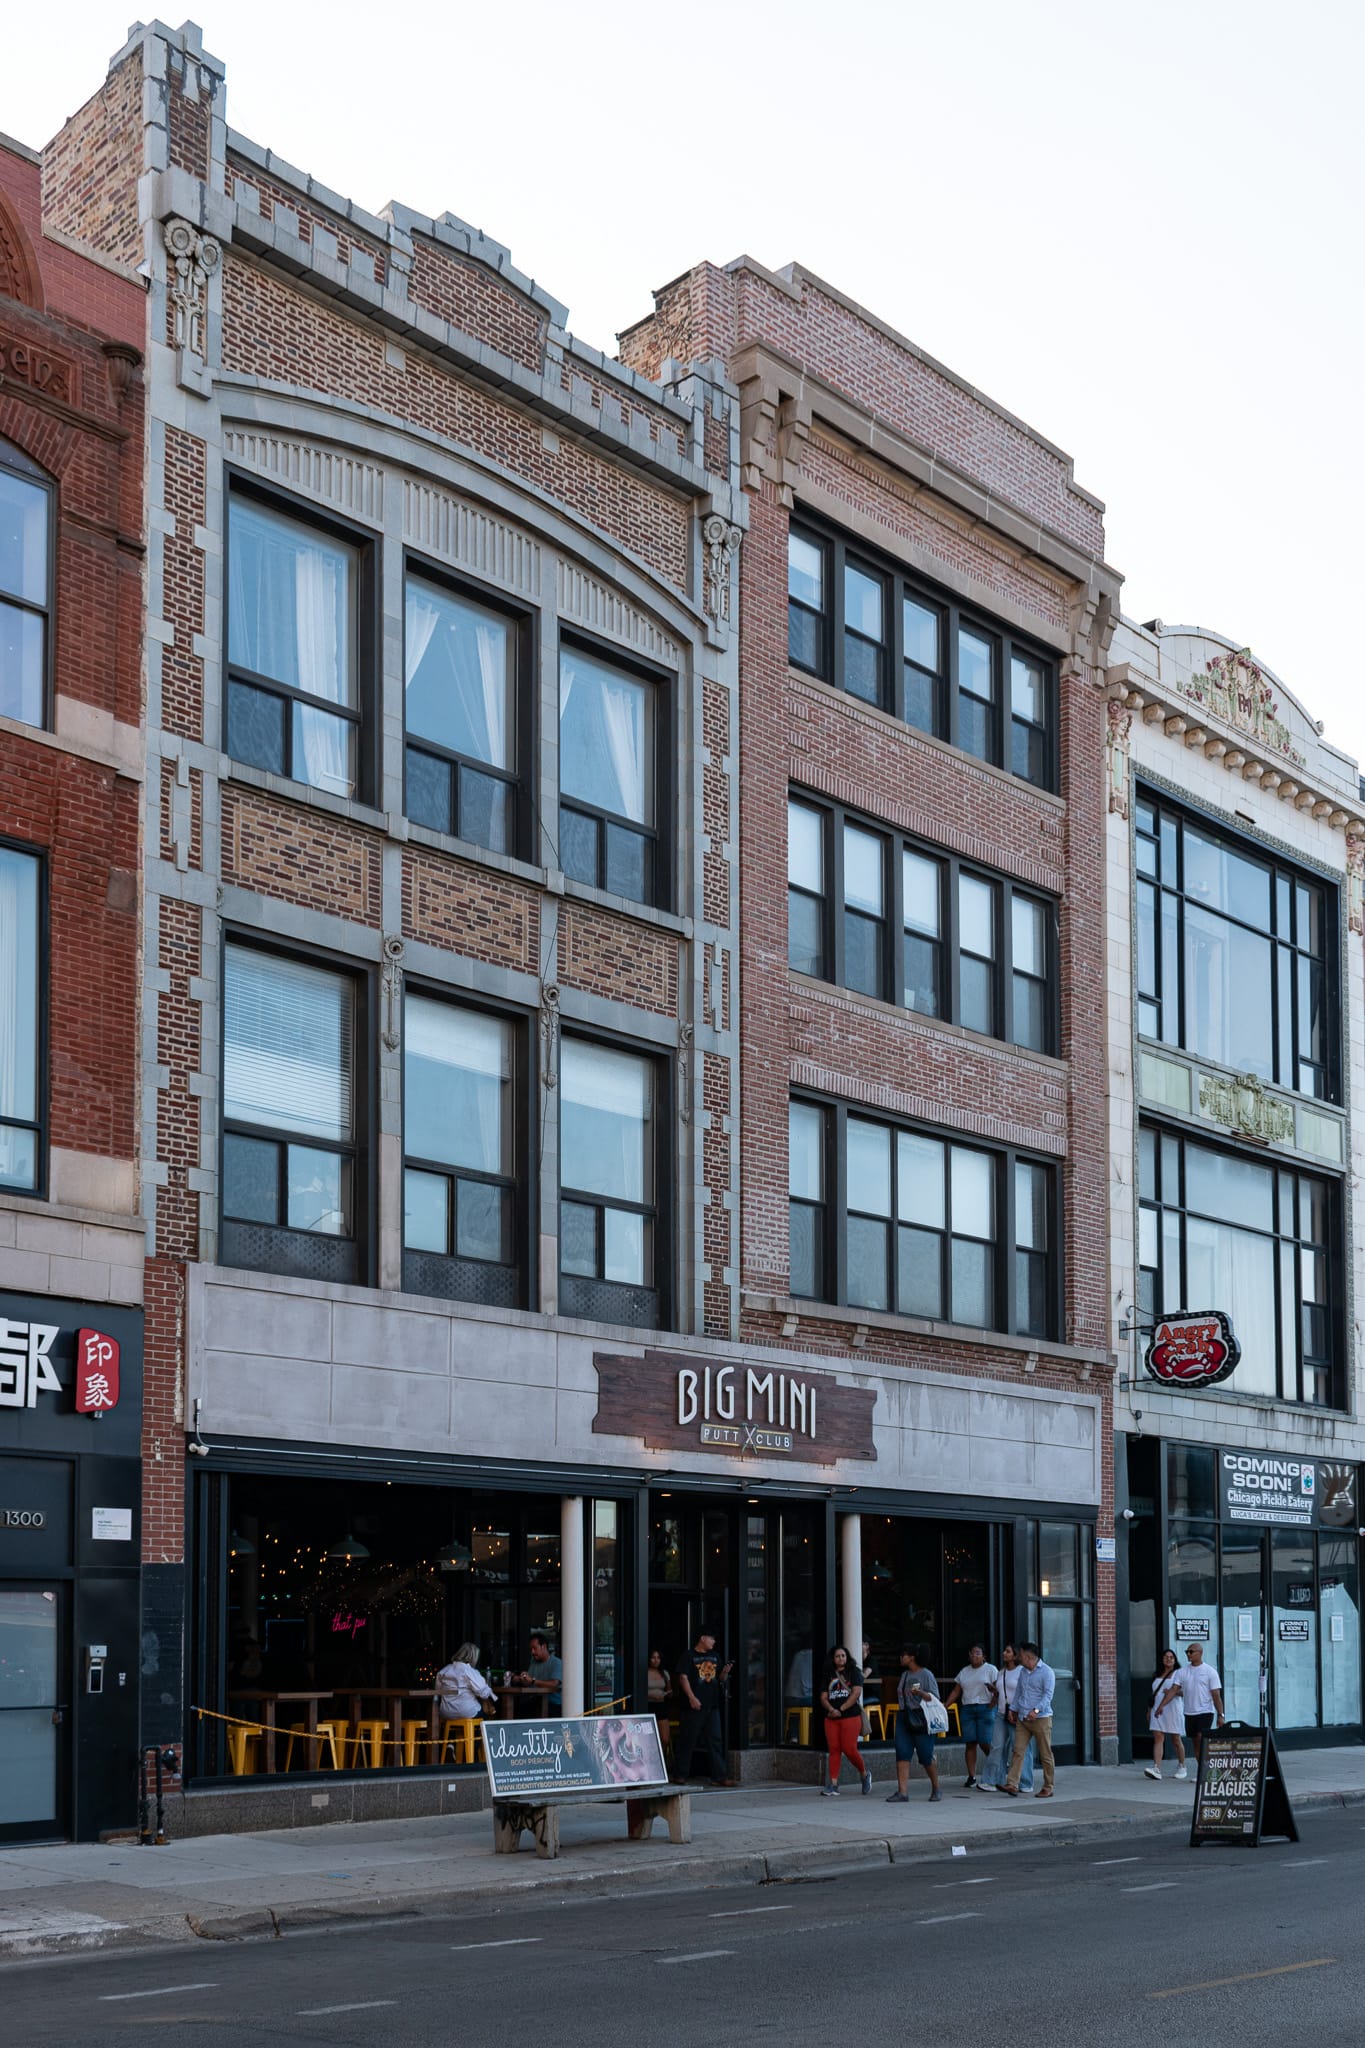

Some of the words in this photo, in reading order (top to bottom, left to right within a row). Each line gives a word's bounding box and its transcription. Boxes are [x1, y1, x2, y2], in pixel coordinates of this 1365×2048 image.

[1157, 1324, 1219, 1342] Angry
[1163, 1338, 1210, 1356] Crab
[85, 1334, 113, 1406] 印象
[679, 1366, 735, 1425] BIG
[747, 1368, 816, 1439] MINI
[703, 1428, 739, 1441] PUTT
[756, 1434, 790, 1448] CLUB
[1223, 1454, 1300, 1476] COMING
[1232, 1472, 1292, 1491] SOON!
[1228, 1488, 1261, 1508] Chicago
[1262, 1491, 1287, 1507] Pickle
[1287, 1494, 1313, 1514] Eatery
[6, 1511, 44, 1526] 1300
[1231, 1510, 1252, 1519] LUCA'S
[1273, 1513, 1297, 1522] DESSERT
[1298, 1515, 1310, 1523] BAR
[490, 1727, 563, 1774] identity
[510, 1758, 527, 1766] BODY
[528, 1756, 555, 1765] PIERCING
[1208, 1758, 1229, 1769] SIGN
[1230, 1758, 1241, 1769] UP
[1242, 1758, 1259, 1769] FOR
[1204, 1782, 1256, 1796] LEAGUES
[1203, 1808, 1220, 1818] $150
[1227, 1808, 1238, 1819] $6
